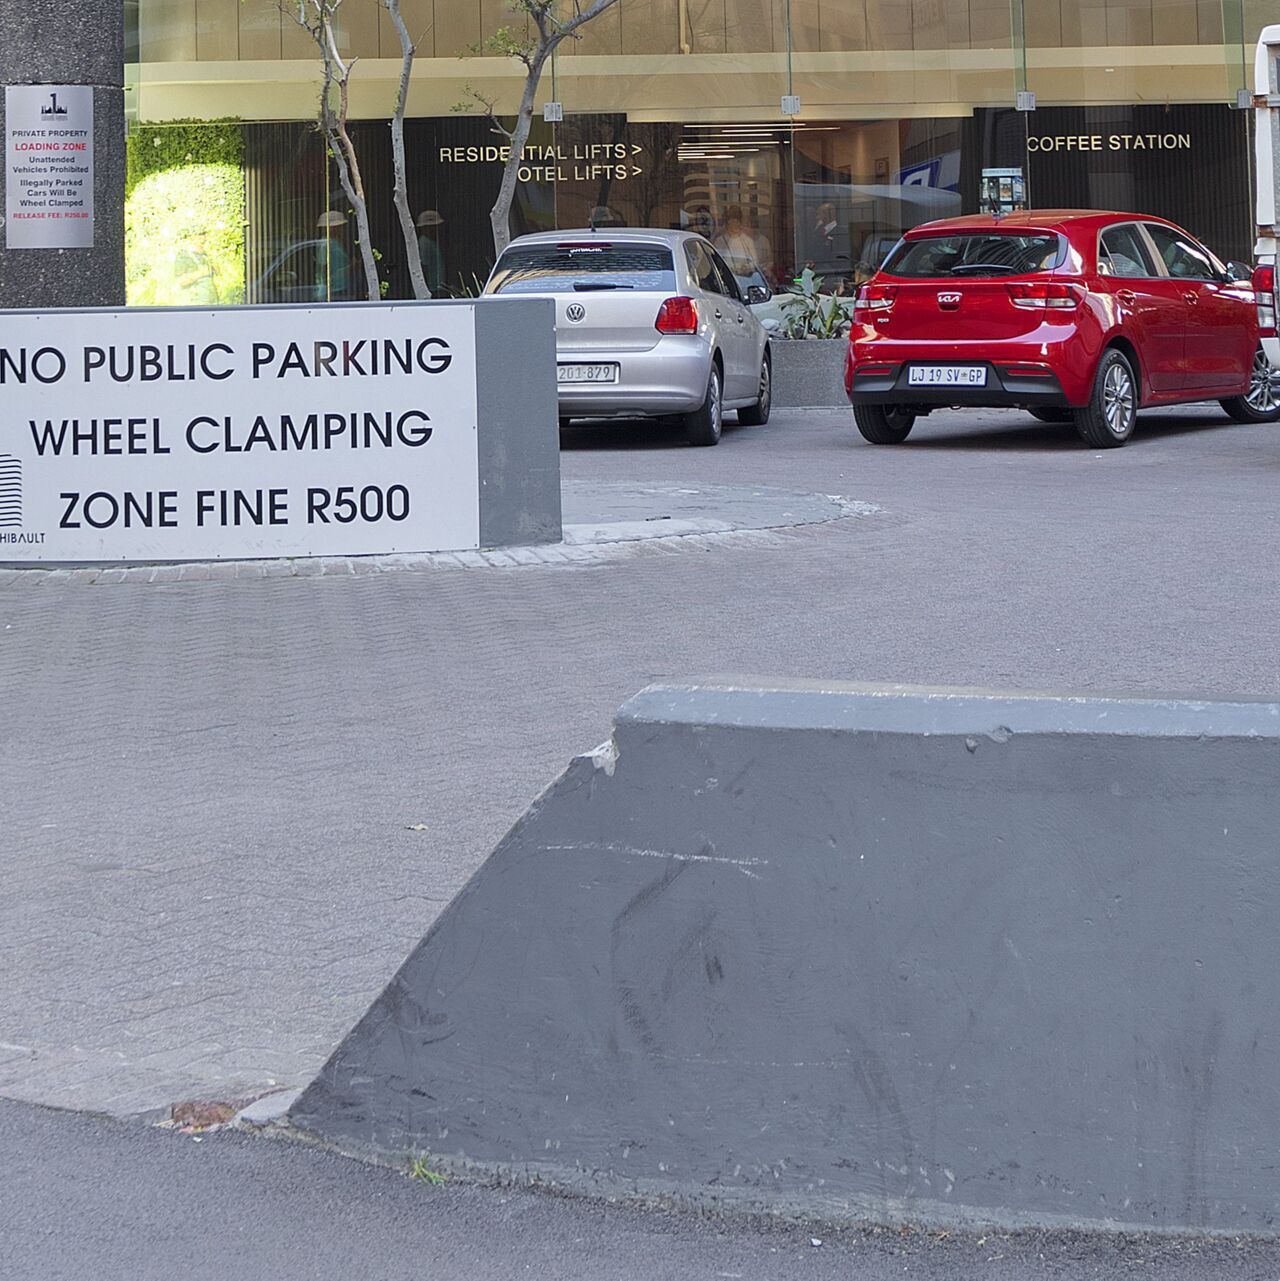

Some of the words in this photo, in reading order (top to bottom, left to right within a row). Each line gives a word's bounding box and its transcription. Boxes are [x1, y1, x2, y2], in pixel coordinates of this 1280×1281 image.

[15, 143, 60, 151] LOADING
[62, 142, 87, 151] ZONE
[1027, 136, 1102, 152] COFFEE
[1108, 134, 1191, 150] STATION
[574, 144, 627, 160] LIFTS
[516, 165, 567, 182] OTEL
[574, 165, 627, 180] LIFTS
[20, 179, 53, 187] Illegally
[27, 189, 47, 197] Cars
[49, 189, 65, 197] Will
[19, 199, 46, 207] Wheel
[48, 199, 83, 208] Clamped
[0, 347, 66, 384] NO
[83, 343, 235, 383] PUBLIC
[252, 337, 453, 379] PARKING
[911, 369, 924, 382] LJ
[929, 369, 942, 382] 19
[947, 369, 960, 382] SV
[969, 369, 982, 382] GP
[29, 418, 170, 456] WHEEL
[186, 410, 433, 453] CLAMPING
[59, 491, 178, 528] ZONE
[196, 488, 288, 527] FINE
[307, 484, 411, 524] R500
